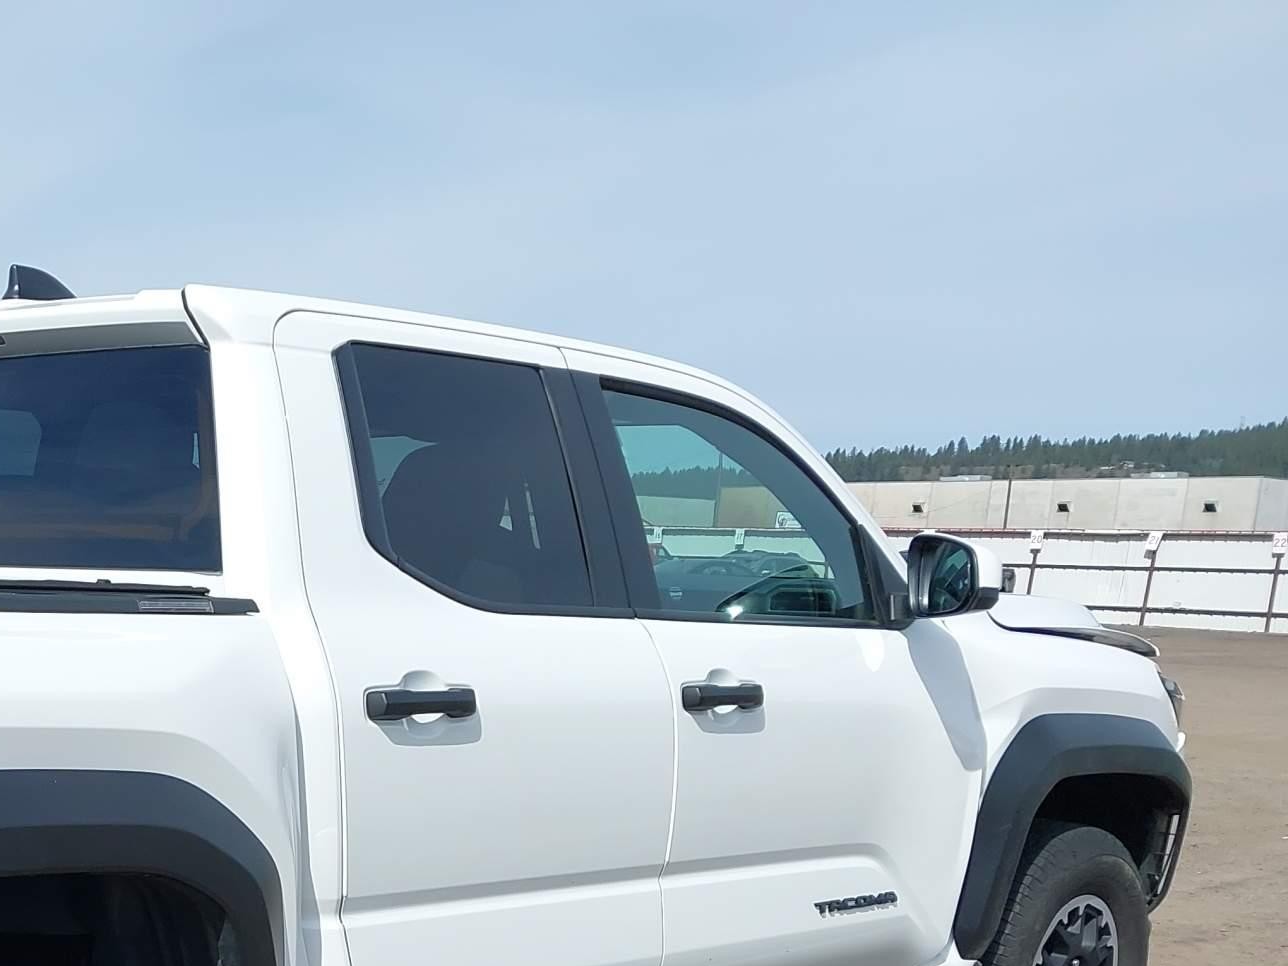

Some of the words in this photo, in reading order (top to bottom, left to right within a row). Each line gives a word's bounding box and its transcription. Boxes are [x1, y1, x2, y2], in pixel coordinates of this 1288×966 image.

[1031, 535, 1043, 544] 20
[1274, 537, 1287, 548] 22
[813, 891, 899, 916] TACOMA
